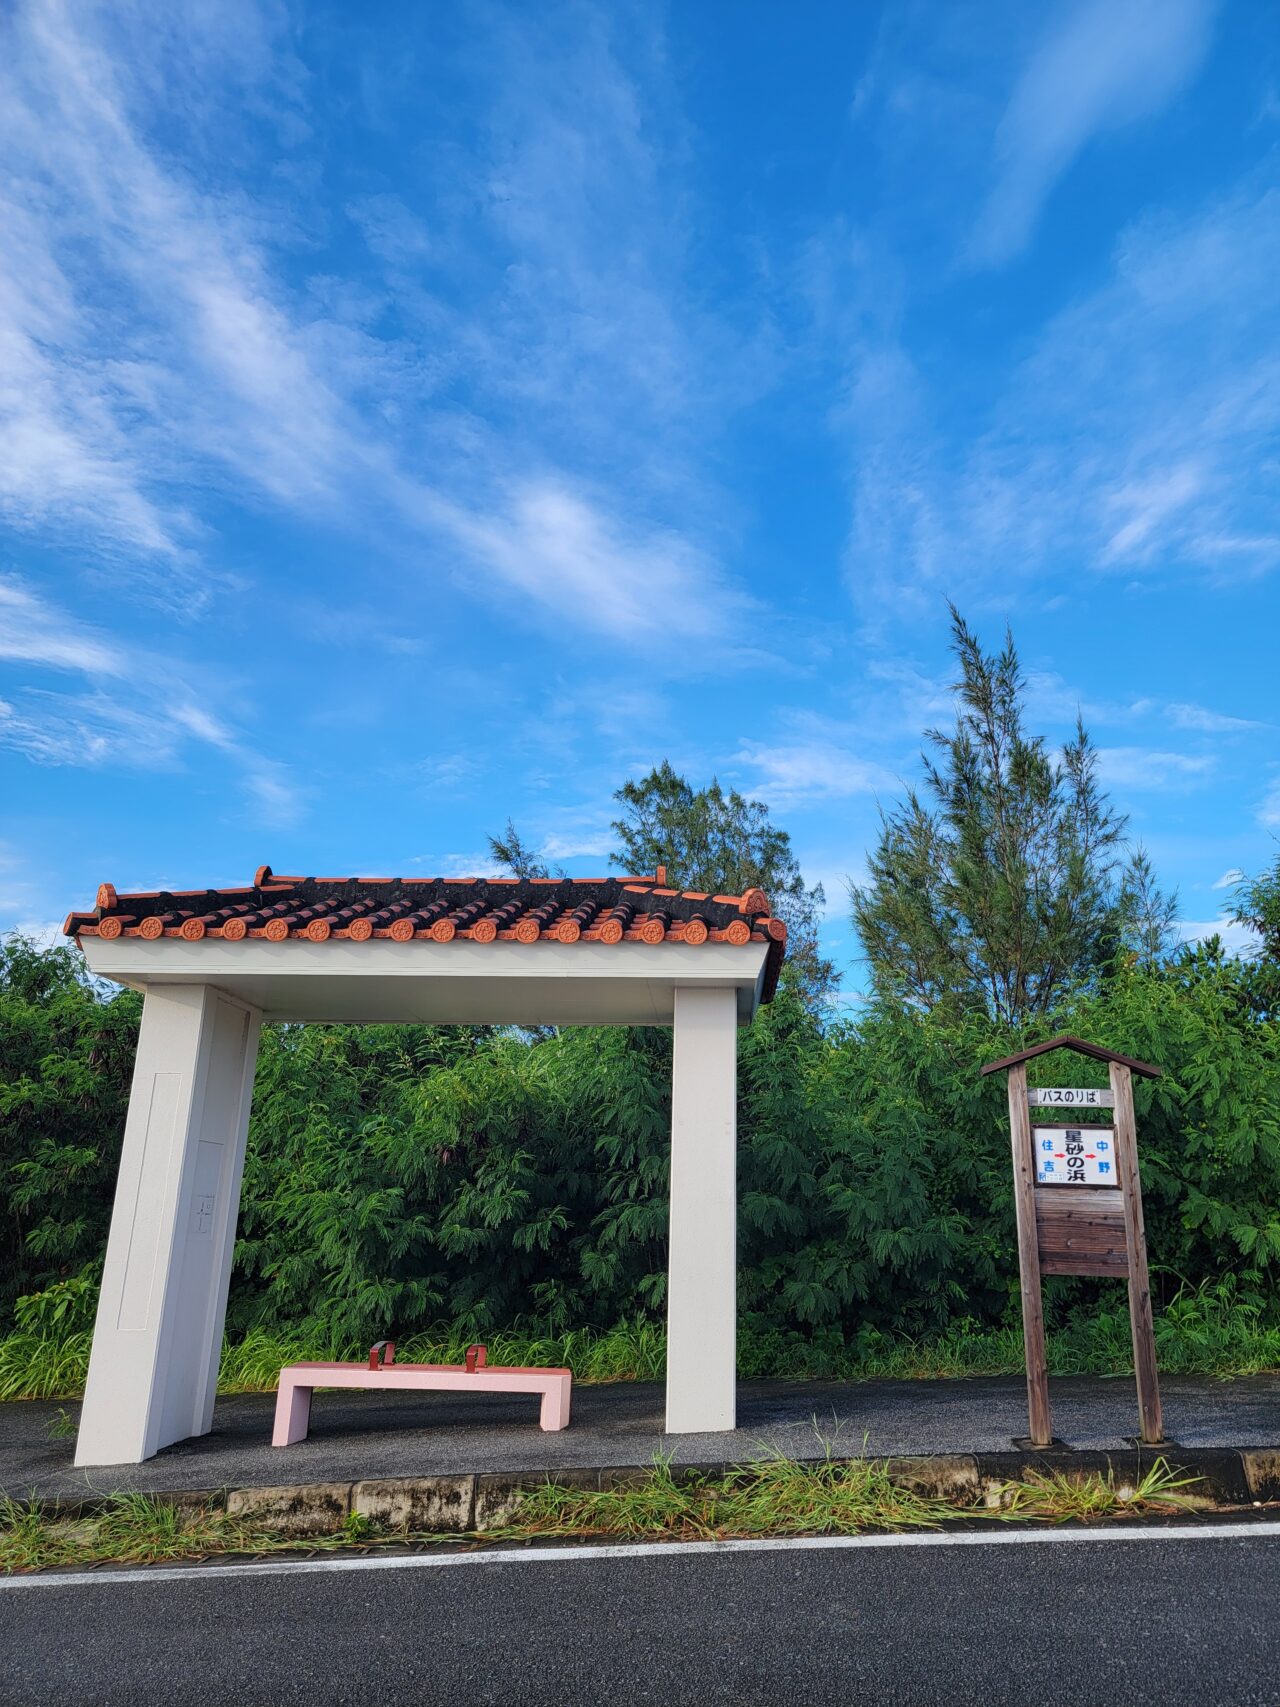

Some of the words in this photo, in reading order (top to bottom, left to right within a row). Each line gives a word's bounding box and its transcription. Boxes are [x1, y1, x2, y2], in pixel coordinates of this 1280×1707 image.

[1042, 1090, 1097, 1103] バスのりば
[1042, 1139, 1055, 1172] 住吉
[1065, 1130, 1086, 1182] 星砂の浜
[1096, 1140, 1111, 1174] 中野
